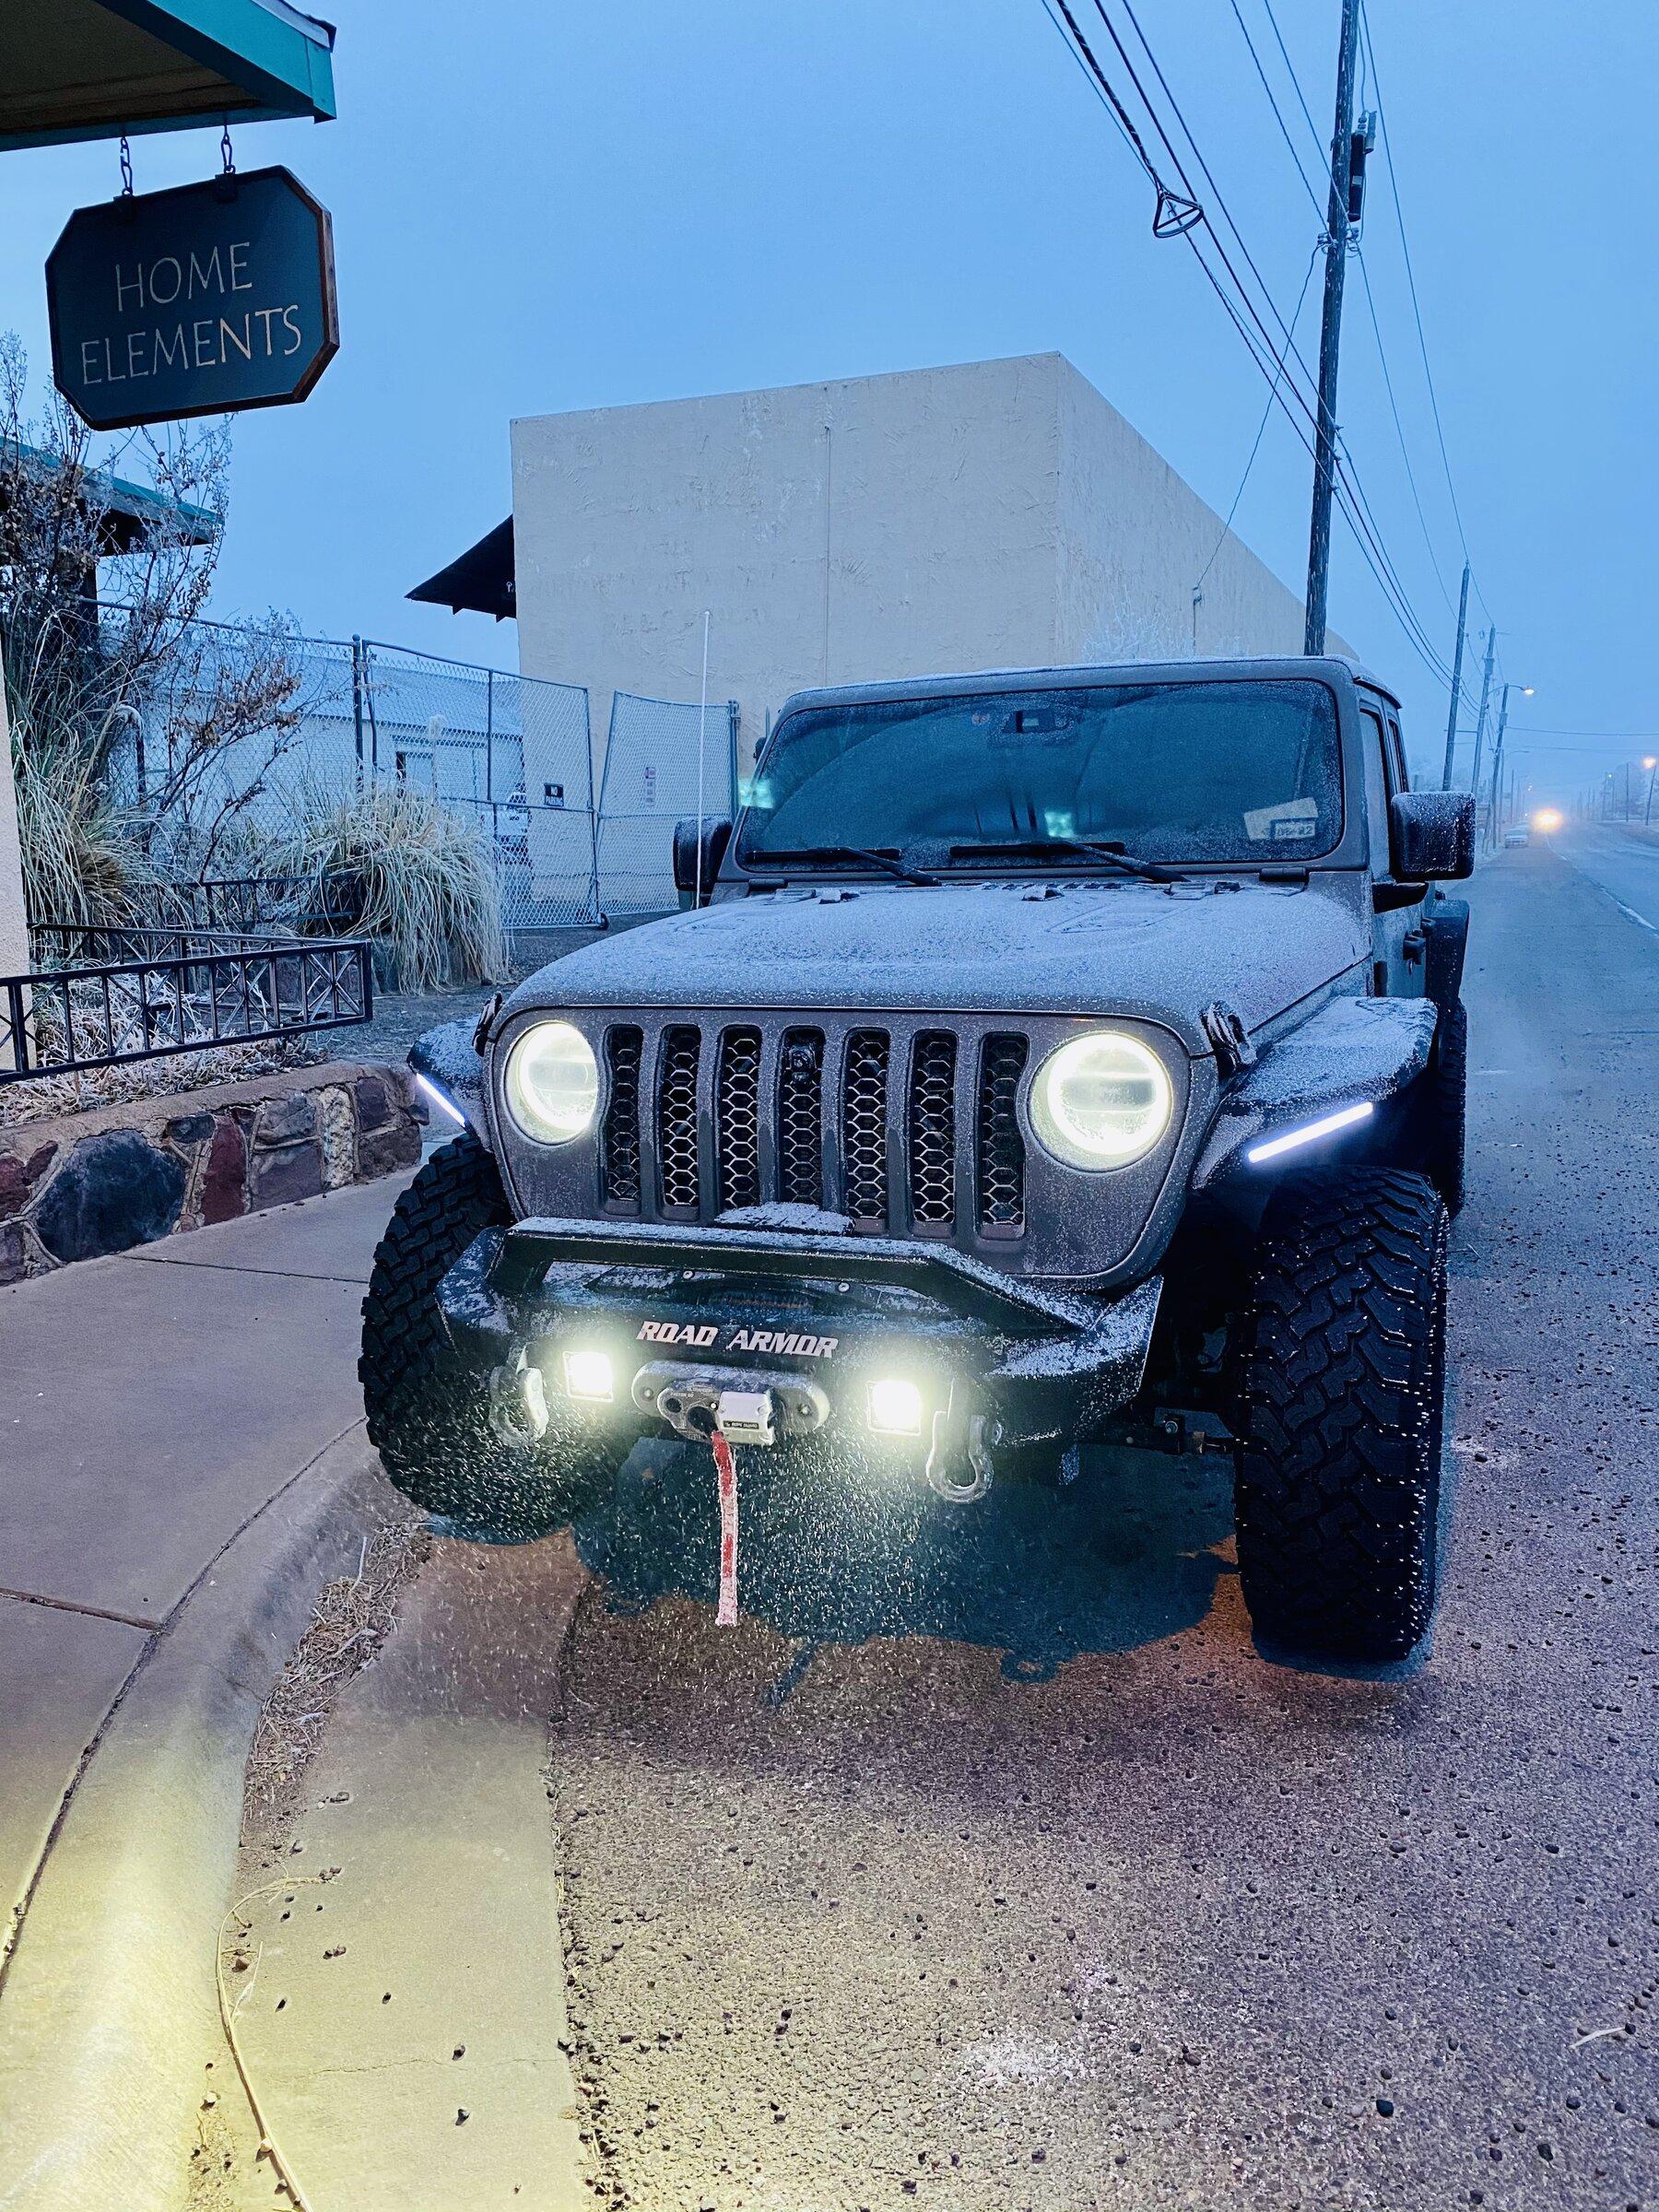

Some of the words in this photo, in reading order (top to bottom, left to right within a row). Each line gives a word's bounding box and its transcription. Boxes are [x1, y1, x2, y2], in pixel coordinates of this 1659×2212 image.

[115, 241, 253, 312] HOME
[80, 304, 301, 385] ELEMENTS
[636, 1320, 719, 1347] ROAD
[725, 1329, 839, 1358] ARMOR
